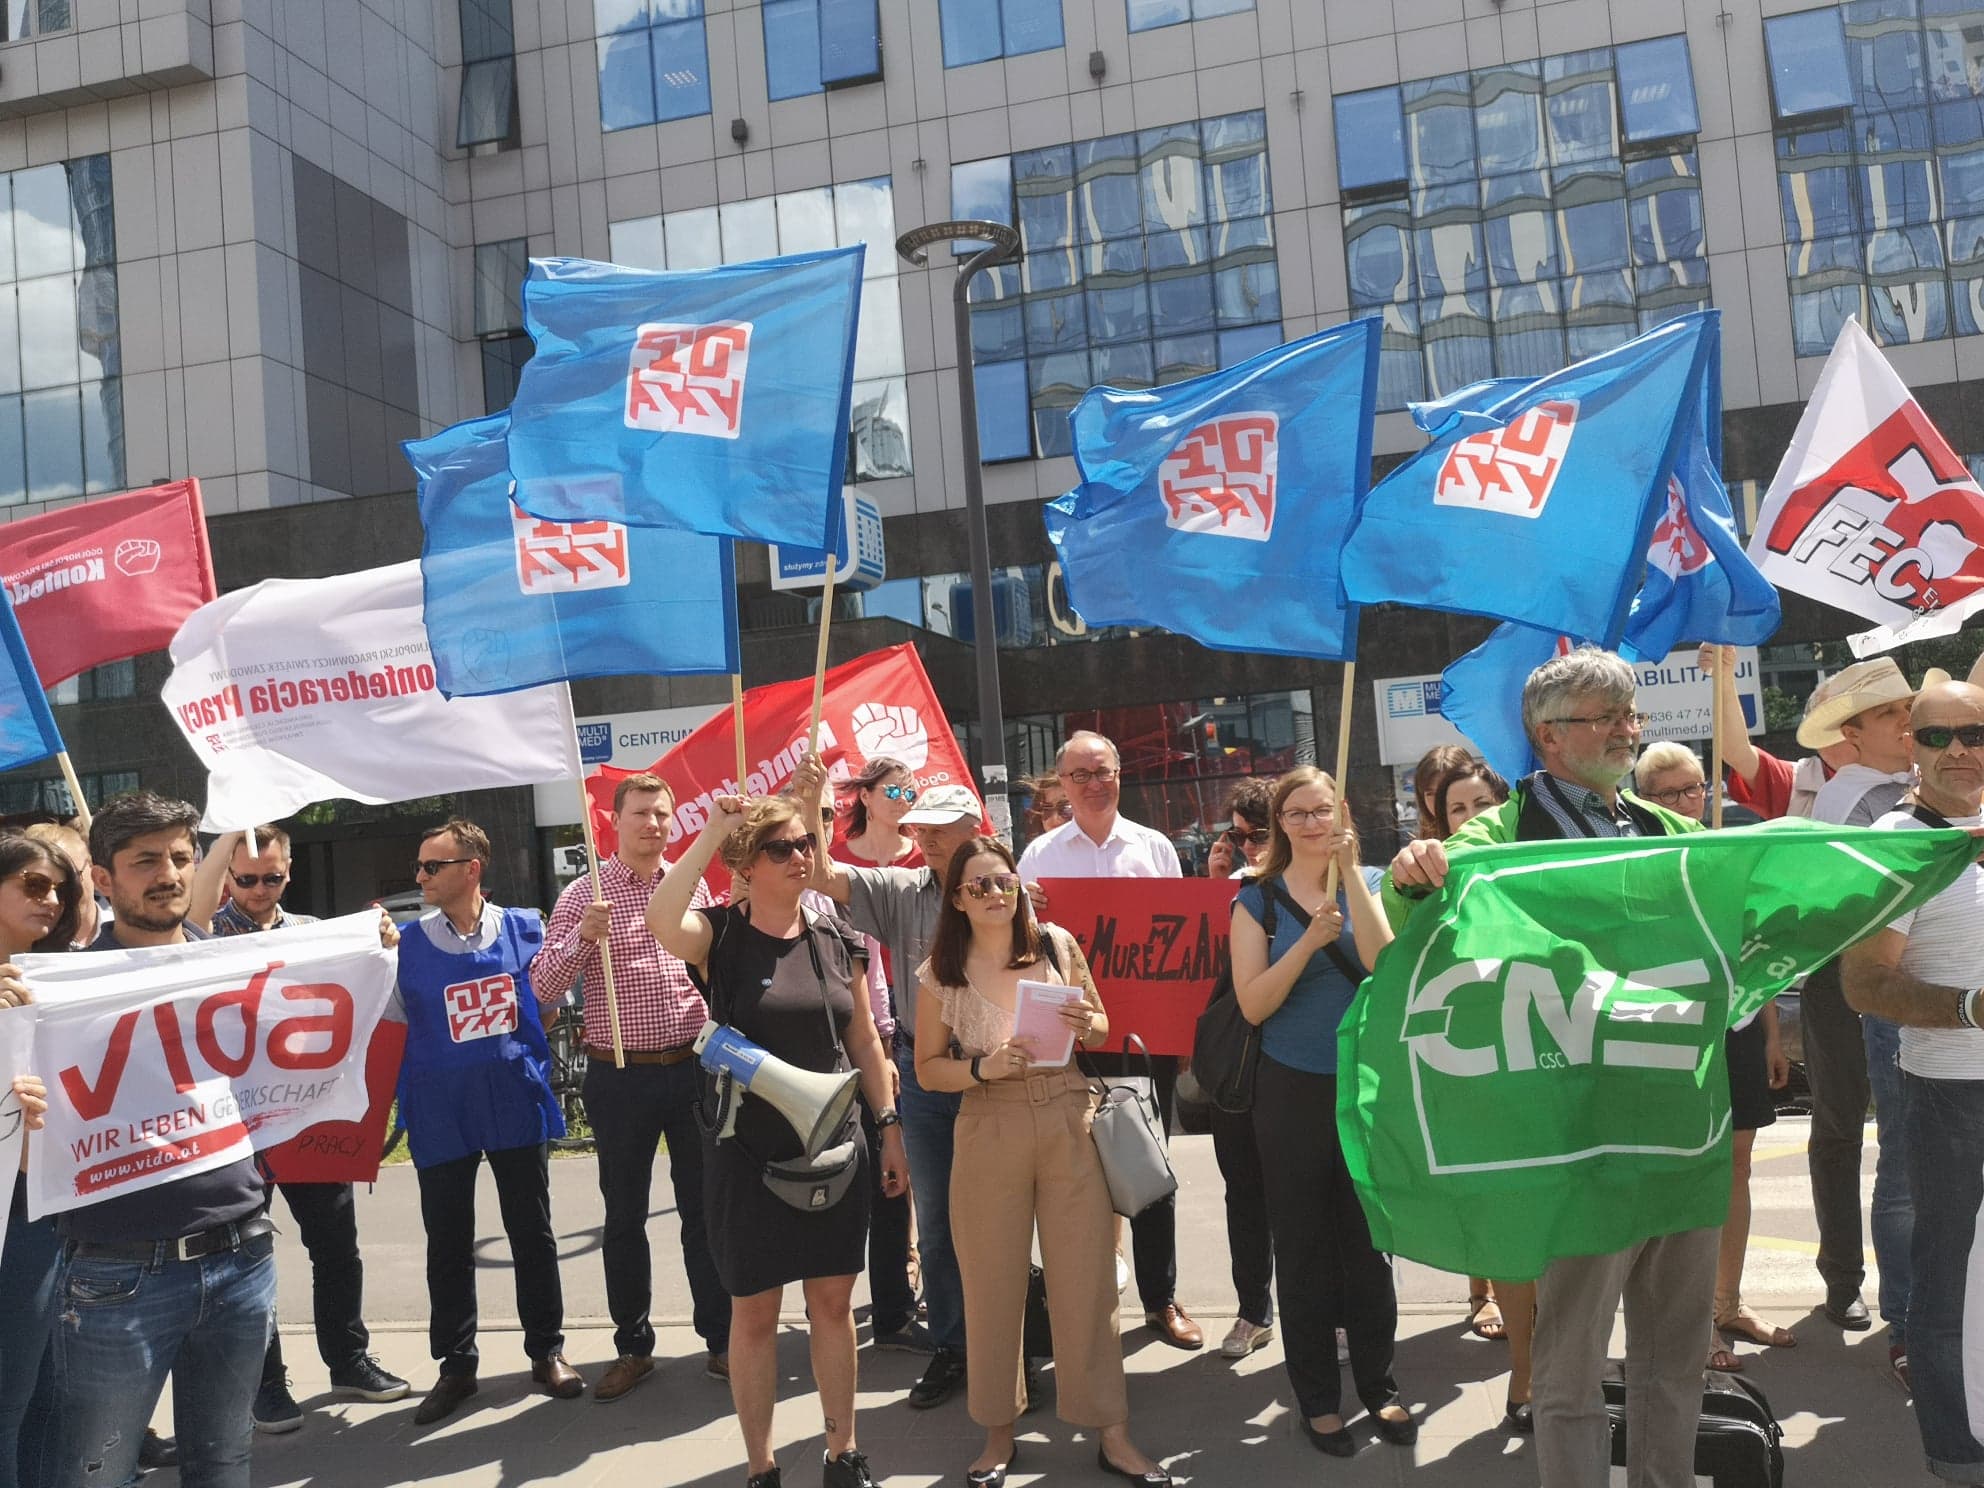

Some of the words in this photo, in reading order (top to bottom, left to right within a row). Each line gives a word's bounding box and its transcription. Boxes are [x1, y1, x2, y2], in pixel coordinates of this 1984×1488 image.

[1793, 503, 1935, 602] FEC
[1677, 709, 1691, 720] 47
[1697, 708, 1711, 718] 74
[577, 725, 608, 736] MULTI
[618, 729, 693, 748] CENTRUM
[1642, 723, 1712, 738] multimed.pl
[1400, 957, 1712, 1077] CNE
[58, 960, 355, 1122] vida
[1539, 1051, 1565, 1070] CSC
[71, 1129, 121, 1163] WIR
[129, 1103, 206, 1145] LEBEN
[297, 1134, 366, 1158] PRACY
[89, 1142, 201, 1184] www.vida.at
